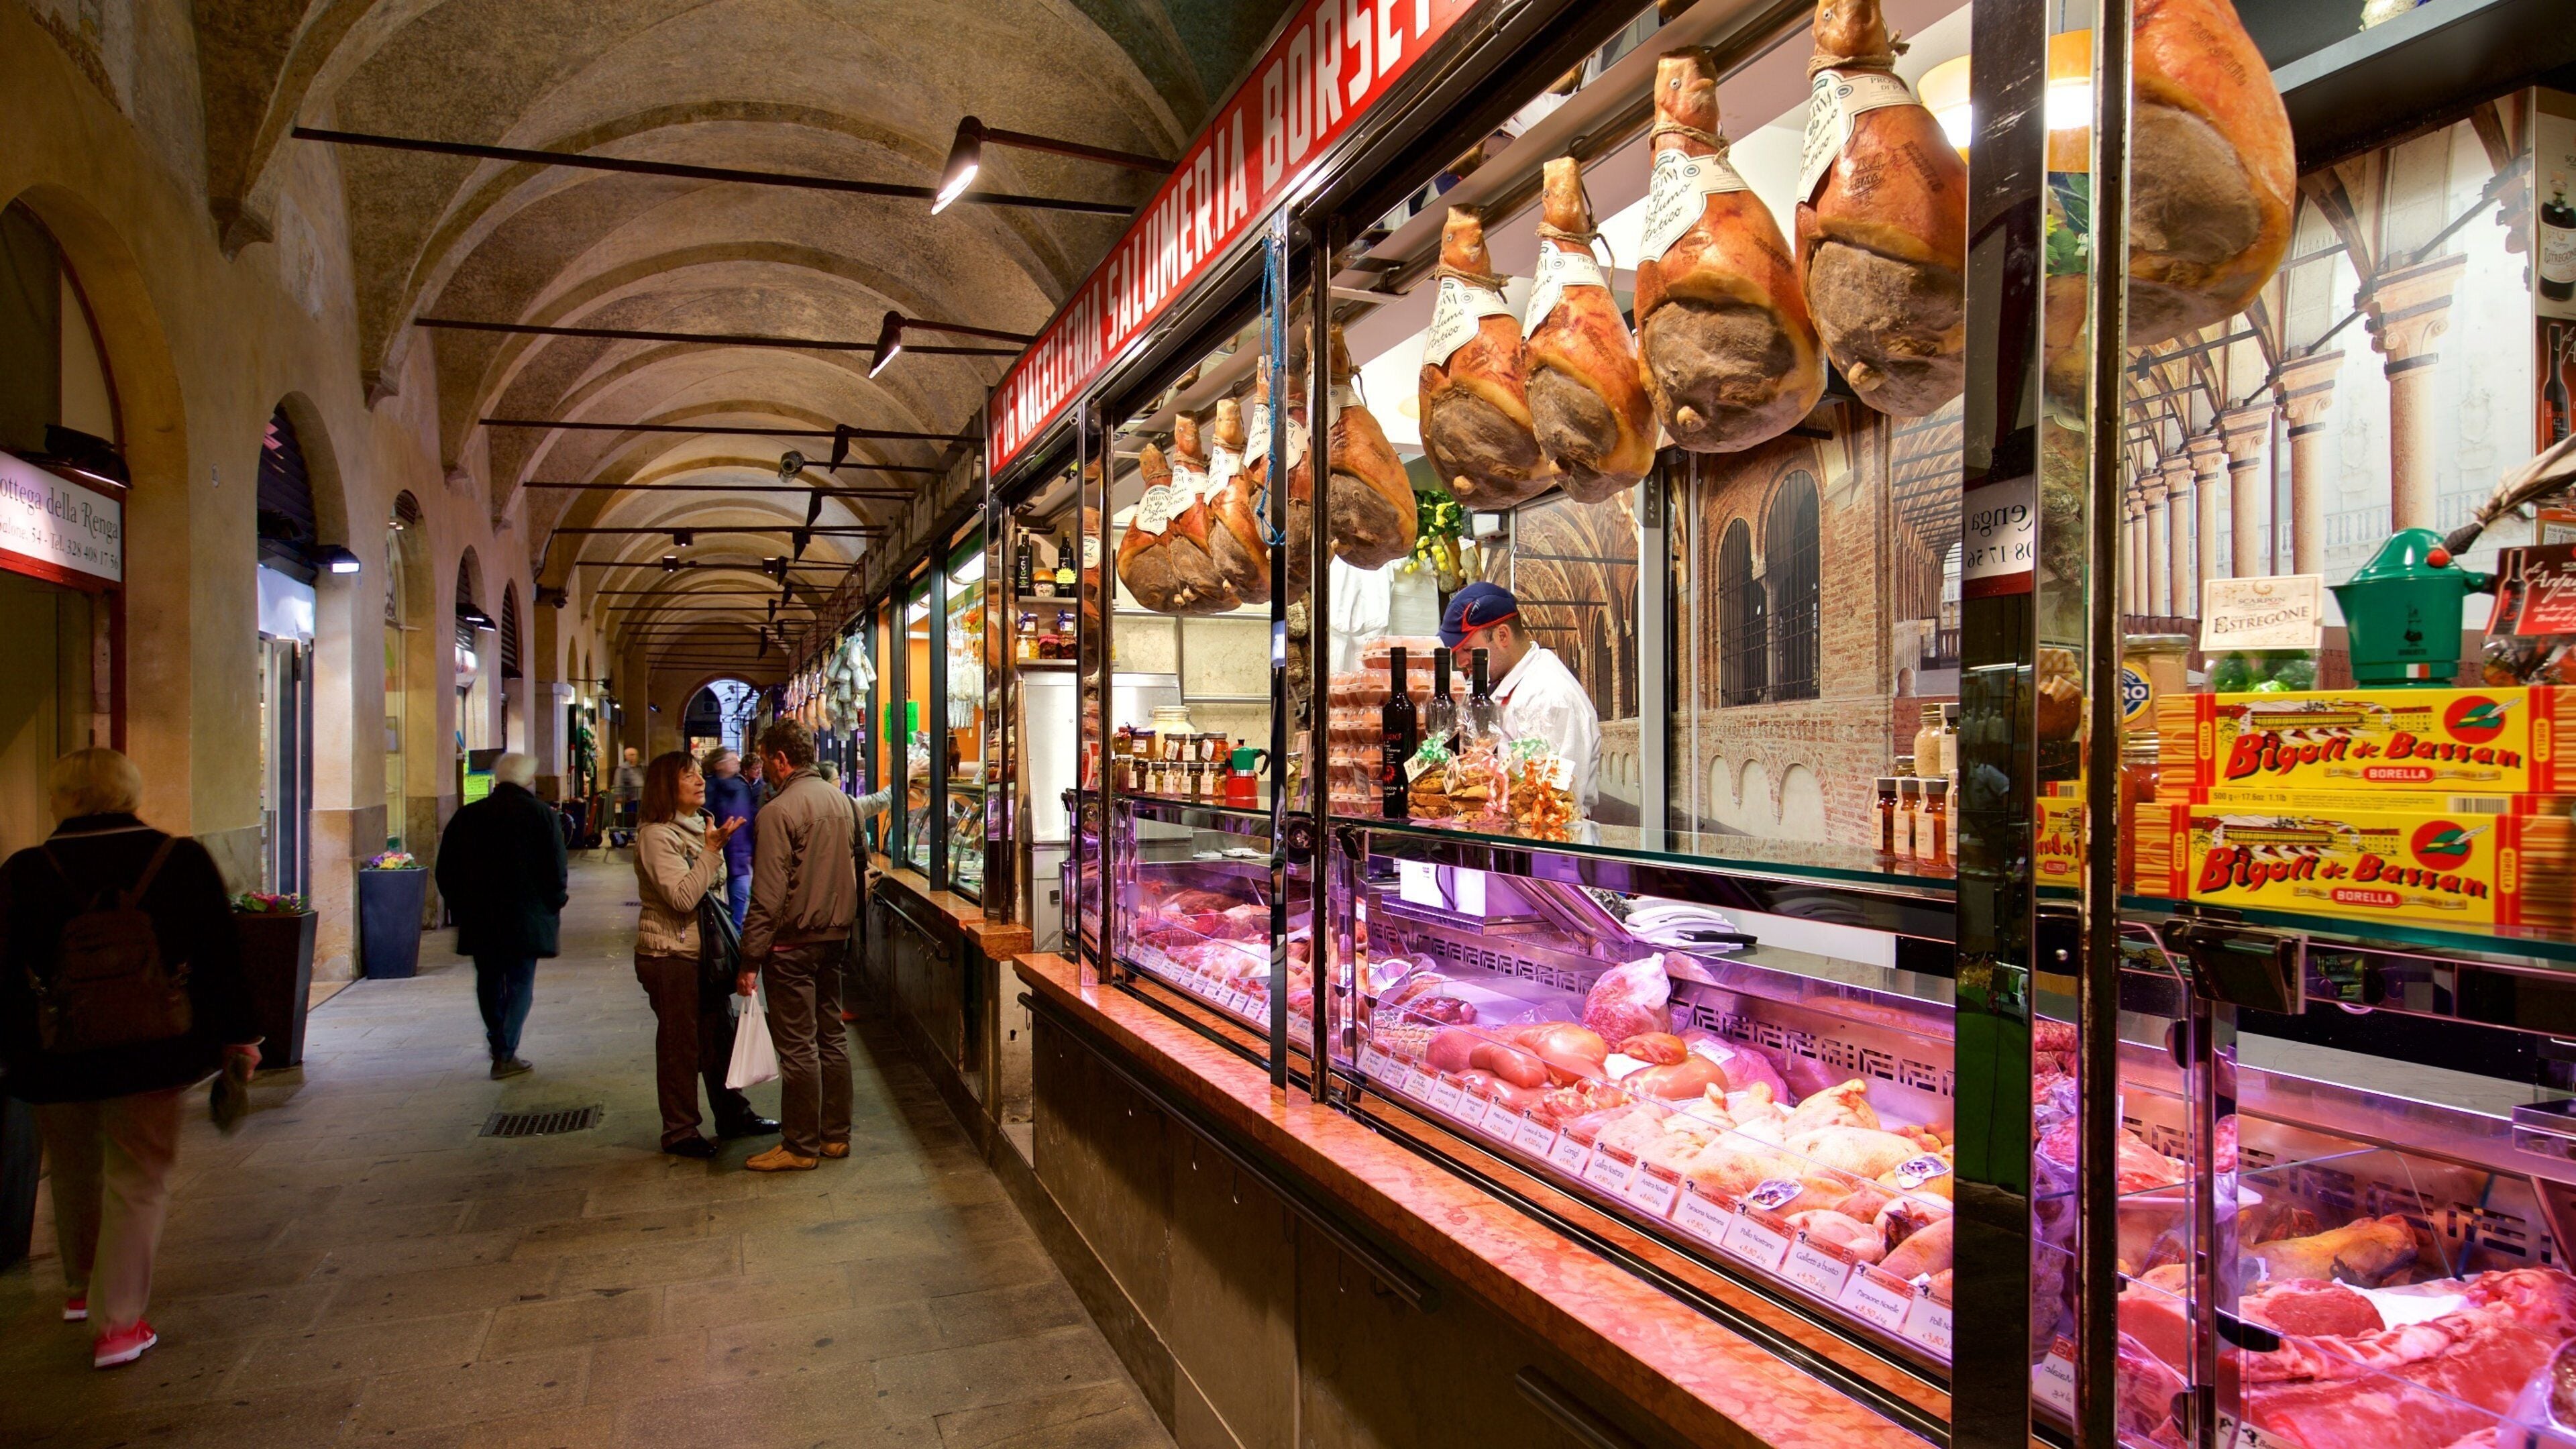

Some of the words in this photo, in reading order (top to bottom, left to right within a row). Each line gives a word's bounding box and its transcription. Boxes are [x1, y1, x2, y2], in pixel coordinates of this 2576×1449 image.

[1002, 390, 1015, 457] 16
[1018, 282, 1102, 442] MACELLERIA
[1108, 106, 1248, 352] SALUMERIA
[0, 477, 42, 516] ottega
[47, 487, 77, 524] della
[80, 501, 119, 545] Renga
[50, 532, 65, 552] Tel.
[67, 539, 82, 558] 328
[84, 545, 97, 564] 408
[2237, 596, 2286, 605] SCARPON
[2122, 686, 2147, 699] RO
[2537, 722, 2545, 758] BORELLA
[2223, 733, 2351, 781] Bigoli
[2352, 741, 2381, 759] de
[2383, 731, 2521, 769] Bassan
[2369, 768, 2428, 780] BORELLA
[2213, 792, 2227, 801] 500
[2195, 847, 2320, 894] Bigoli
[2320, 861, 2349, 880] de
[2351, 853, 2487, 900] Bassan
[2503, 852, 2512, 888] BORELLA
[2337, 890, 2394, 904] BORELLA
[1739, 1227, 1754, 1238] Pollo
[1752, 1234, 1776, 1250] Nostrano
[1821, 1260, 1840, 1275] busto
